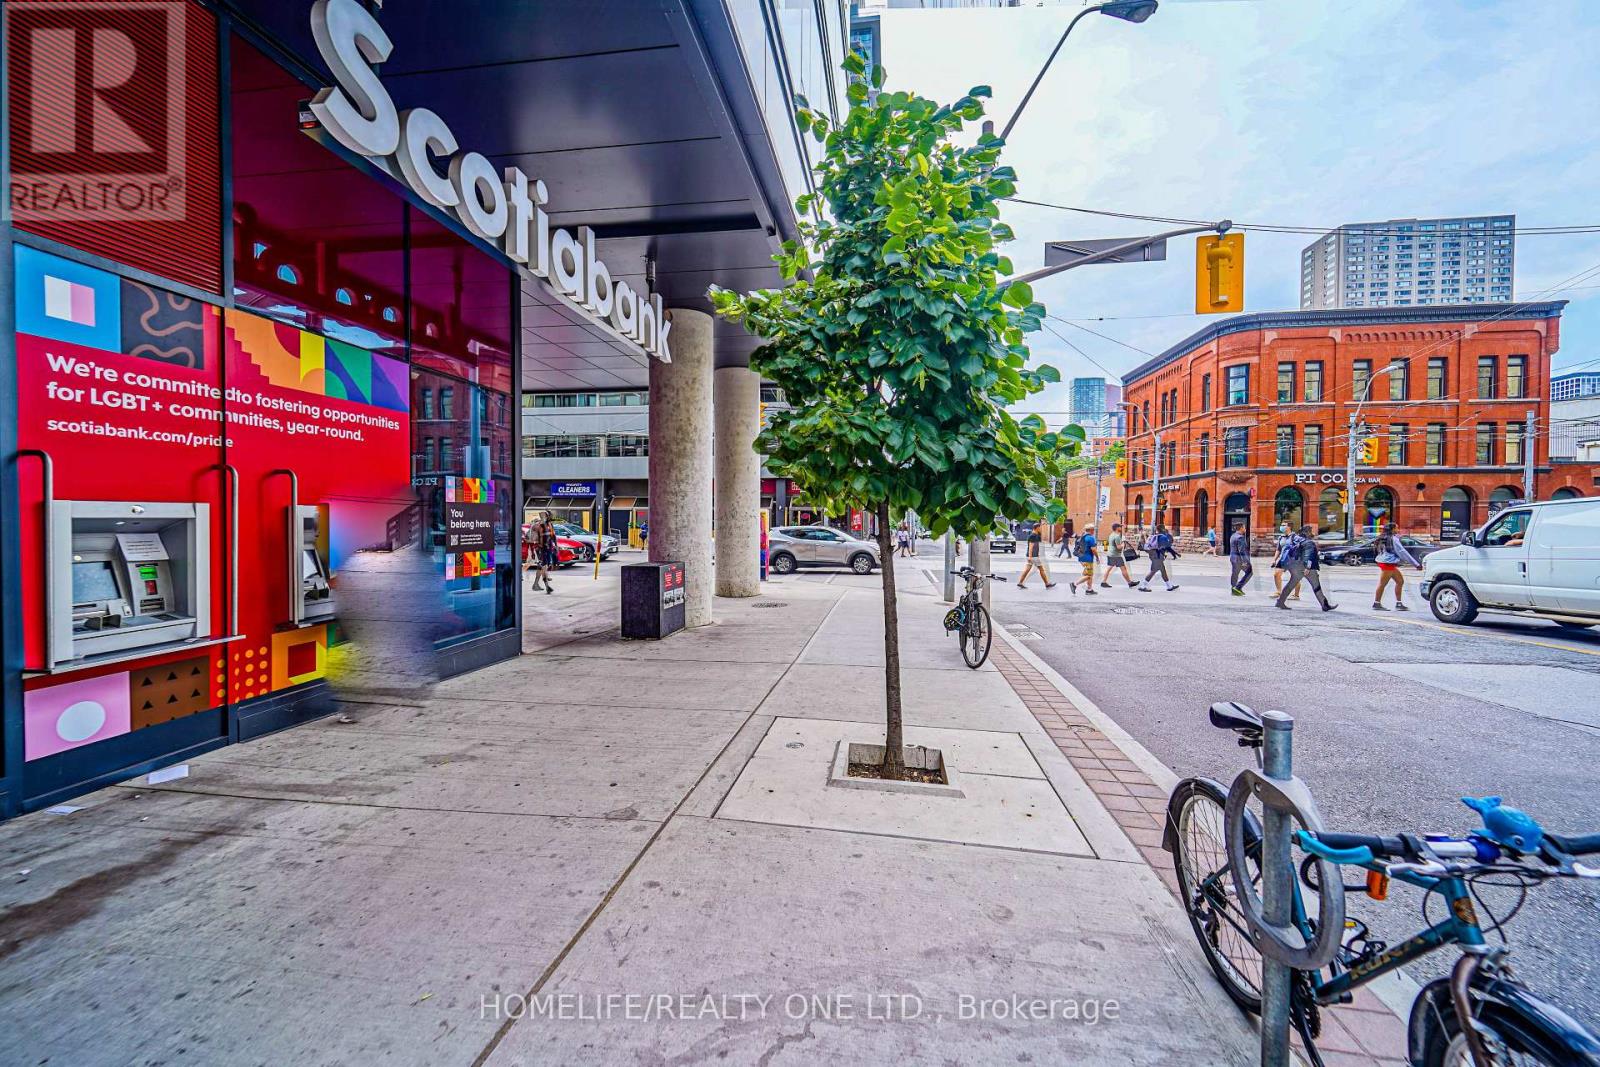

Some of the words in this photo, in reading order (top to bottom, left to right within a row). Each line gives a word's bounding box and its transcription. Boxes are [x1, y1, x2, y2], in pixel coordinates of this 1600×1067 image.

[309, 0, 672, 363] Scotiabank
[46, 353, 118, 381] We're
[256, 393, 320, 418] fostering
[323, 407, 400, 430] opportunities
[46, 381, 85, 402] for
[287, 420, 364, 441] year-round.
[47, 419, 234, 447] scotiabank.com/pride
[1295, 473, 1316, 483] PI
[1321, 473, 1346, 483] CO.
[450, 509, 463, 518] You
[450, 519, 474, 530] belong
[475, 520, 490, 528] here.
